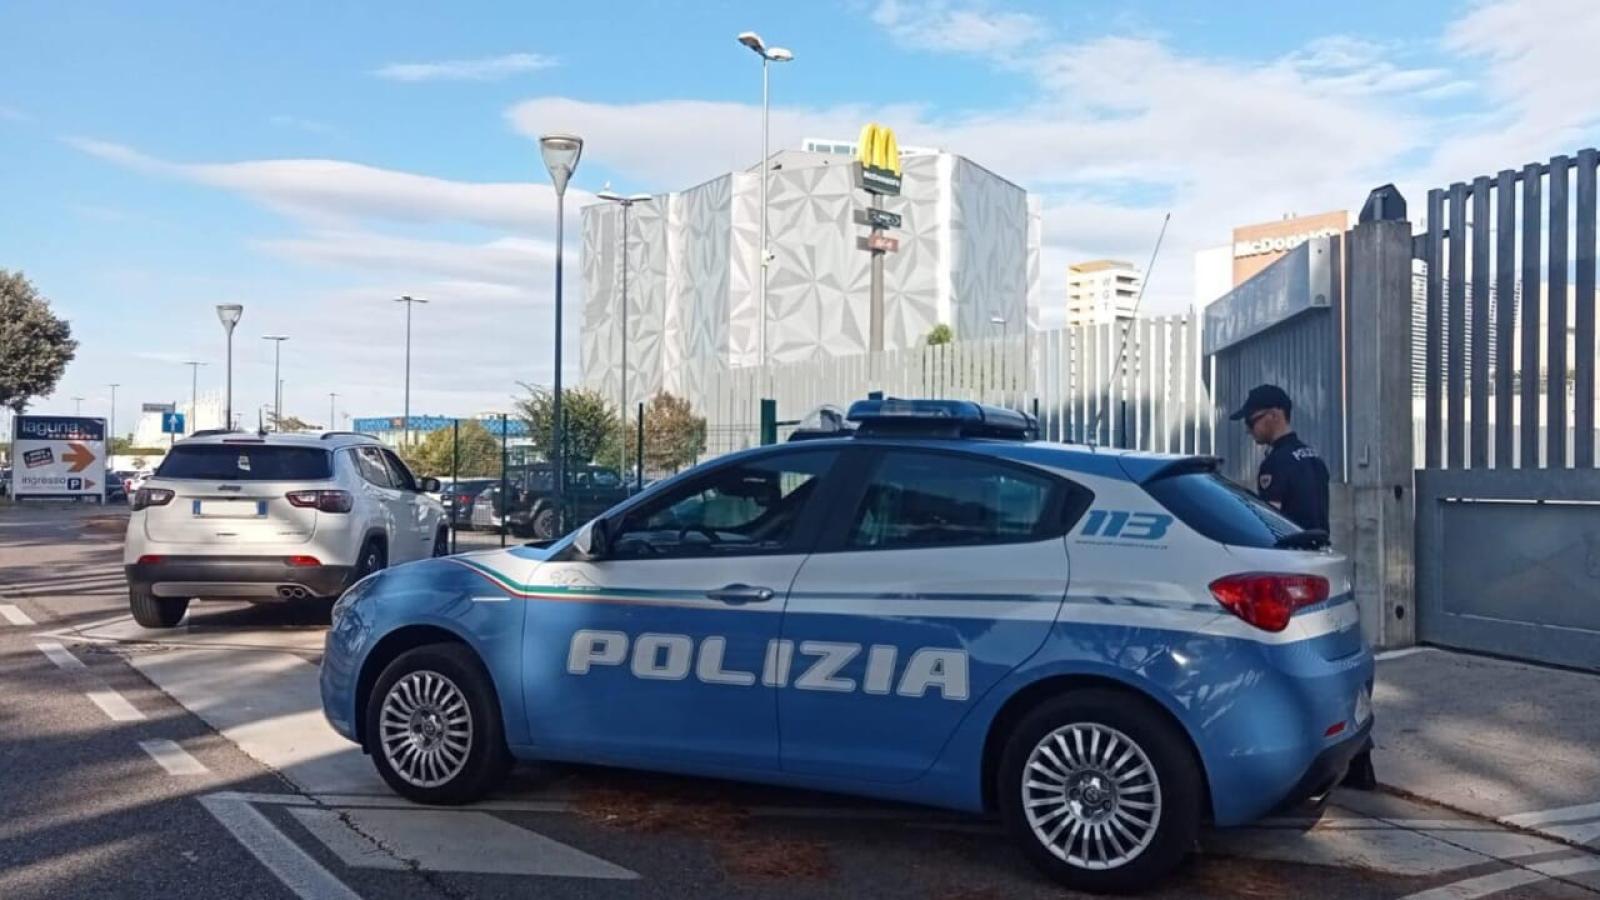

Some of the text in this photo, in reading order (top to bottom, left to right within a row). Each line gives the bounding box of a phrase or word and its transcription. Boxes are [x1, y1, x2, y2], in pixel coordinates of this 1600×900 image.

[22, 419, 79, 436] laguna
[22, 474, 66, 486] ingresso
[1079, 509, 1174, 541] 113
[565, 628, 971, 701] POLIZIA
